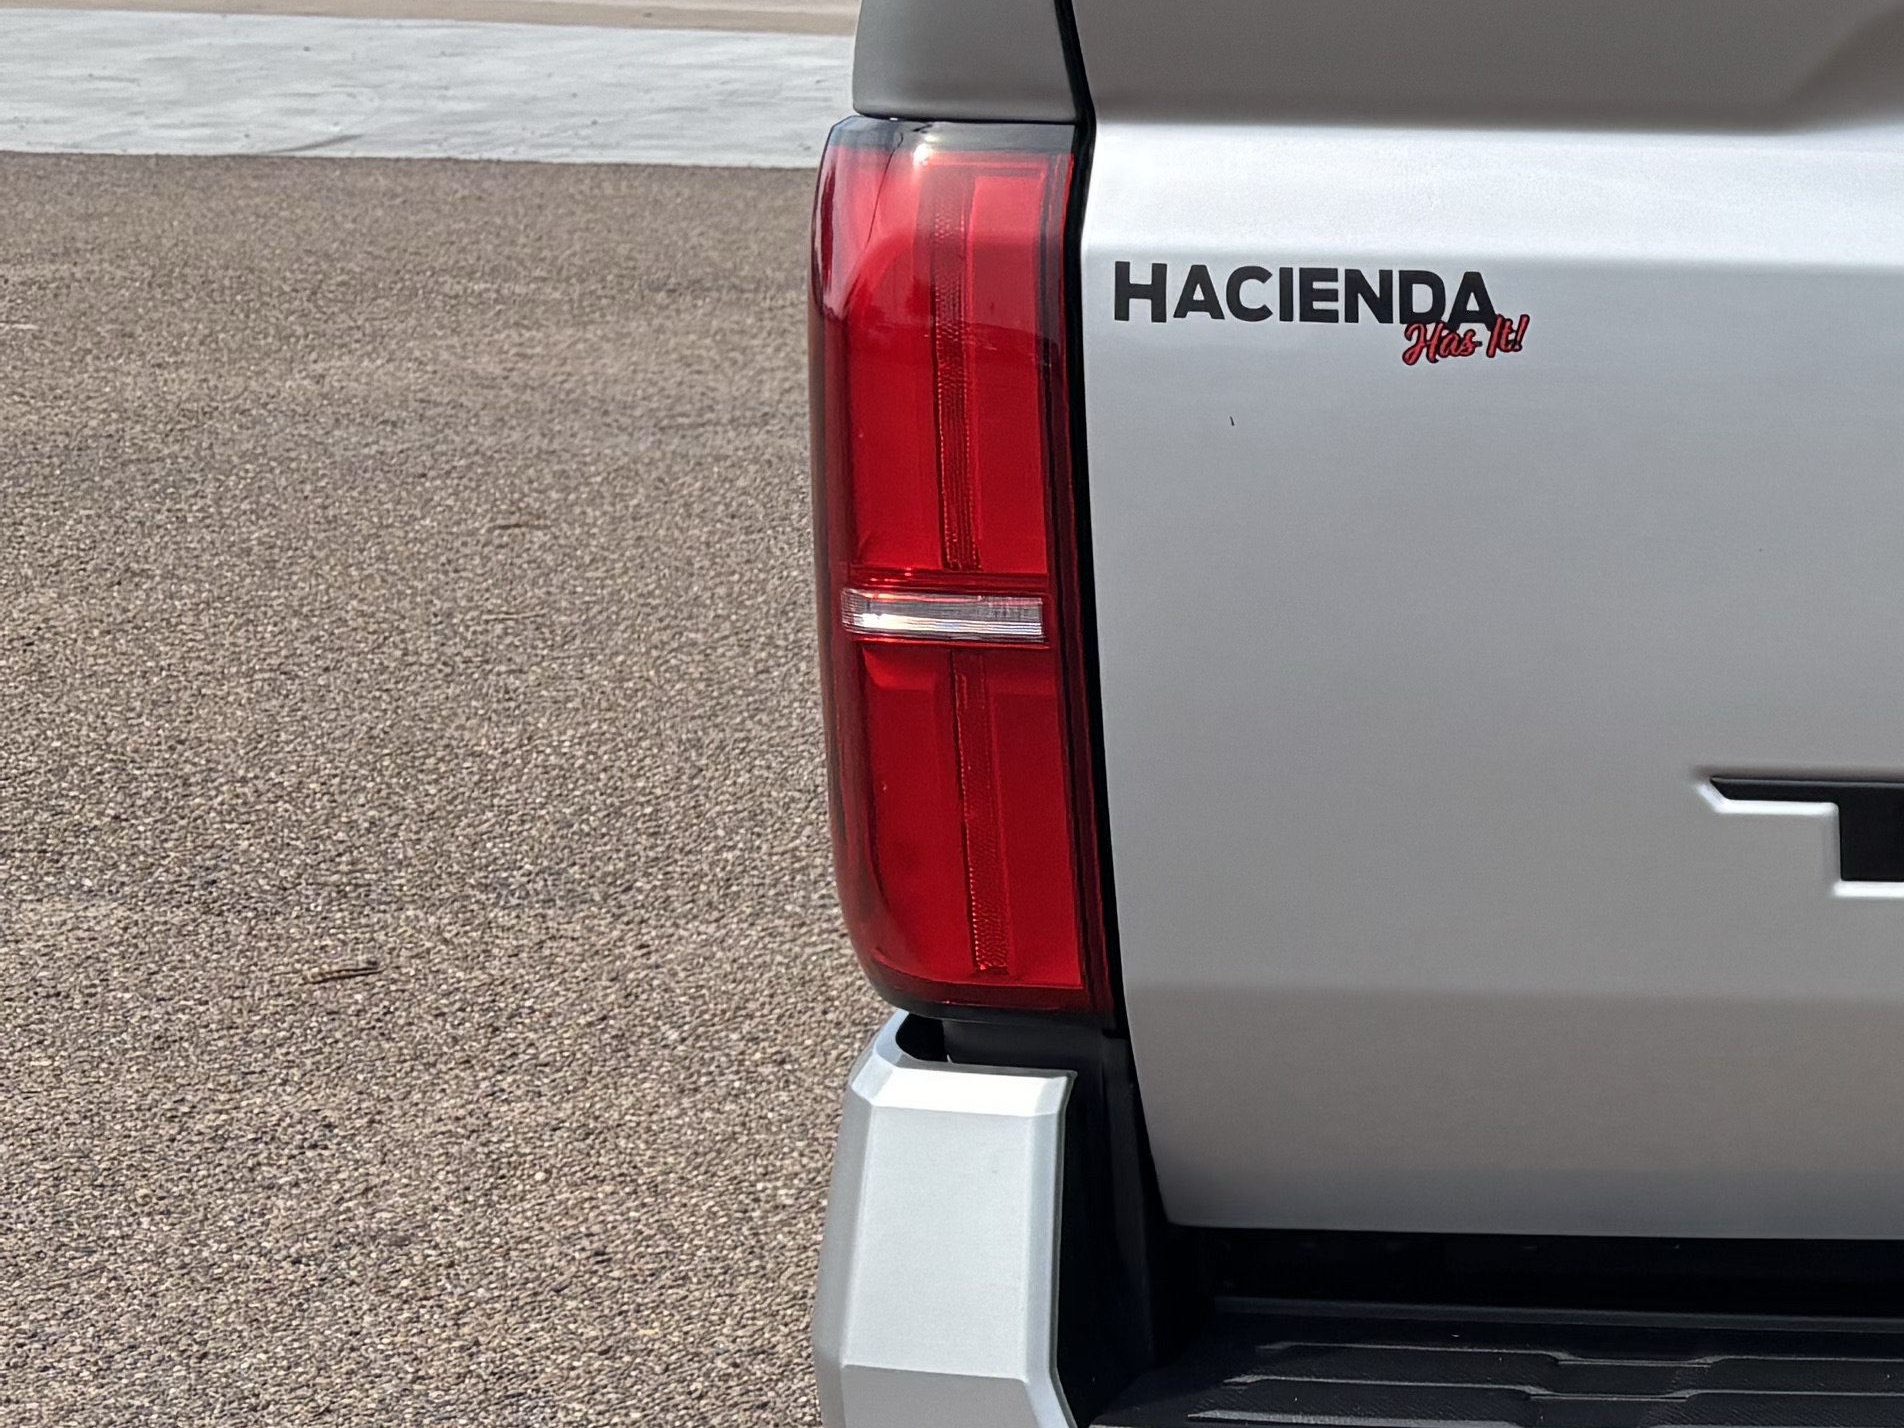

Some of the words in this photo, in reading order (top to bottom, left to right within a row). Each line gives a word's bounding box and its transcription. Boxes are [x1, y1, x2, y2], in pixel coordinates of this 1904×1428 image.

[1114, 261, 1499, 332] HACIENDA
[1402, 322, 1482, 366] Has
[1486, 314, 1530, 359] It!
